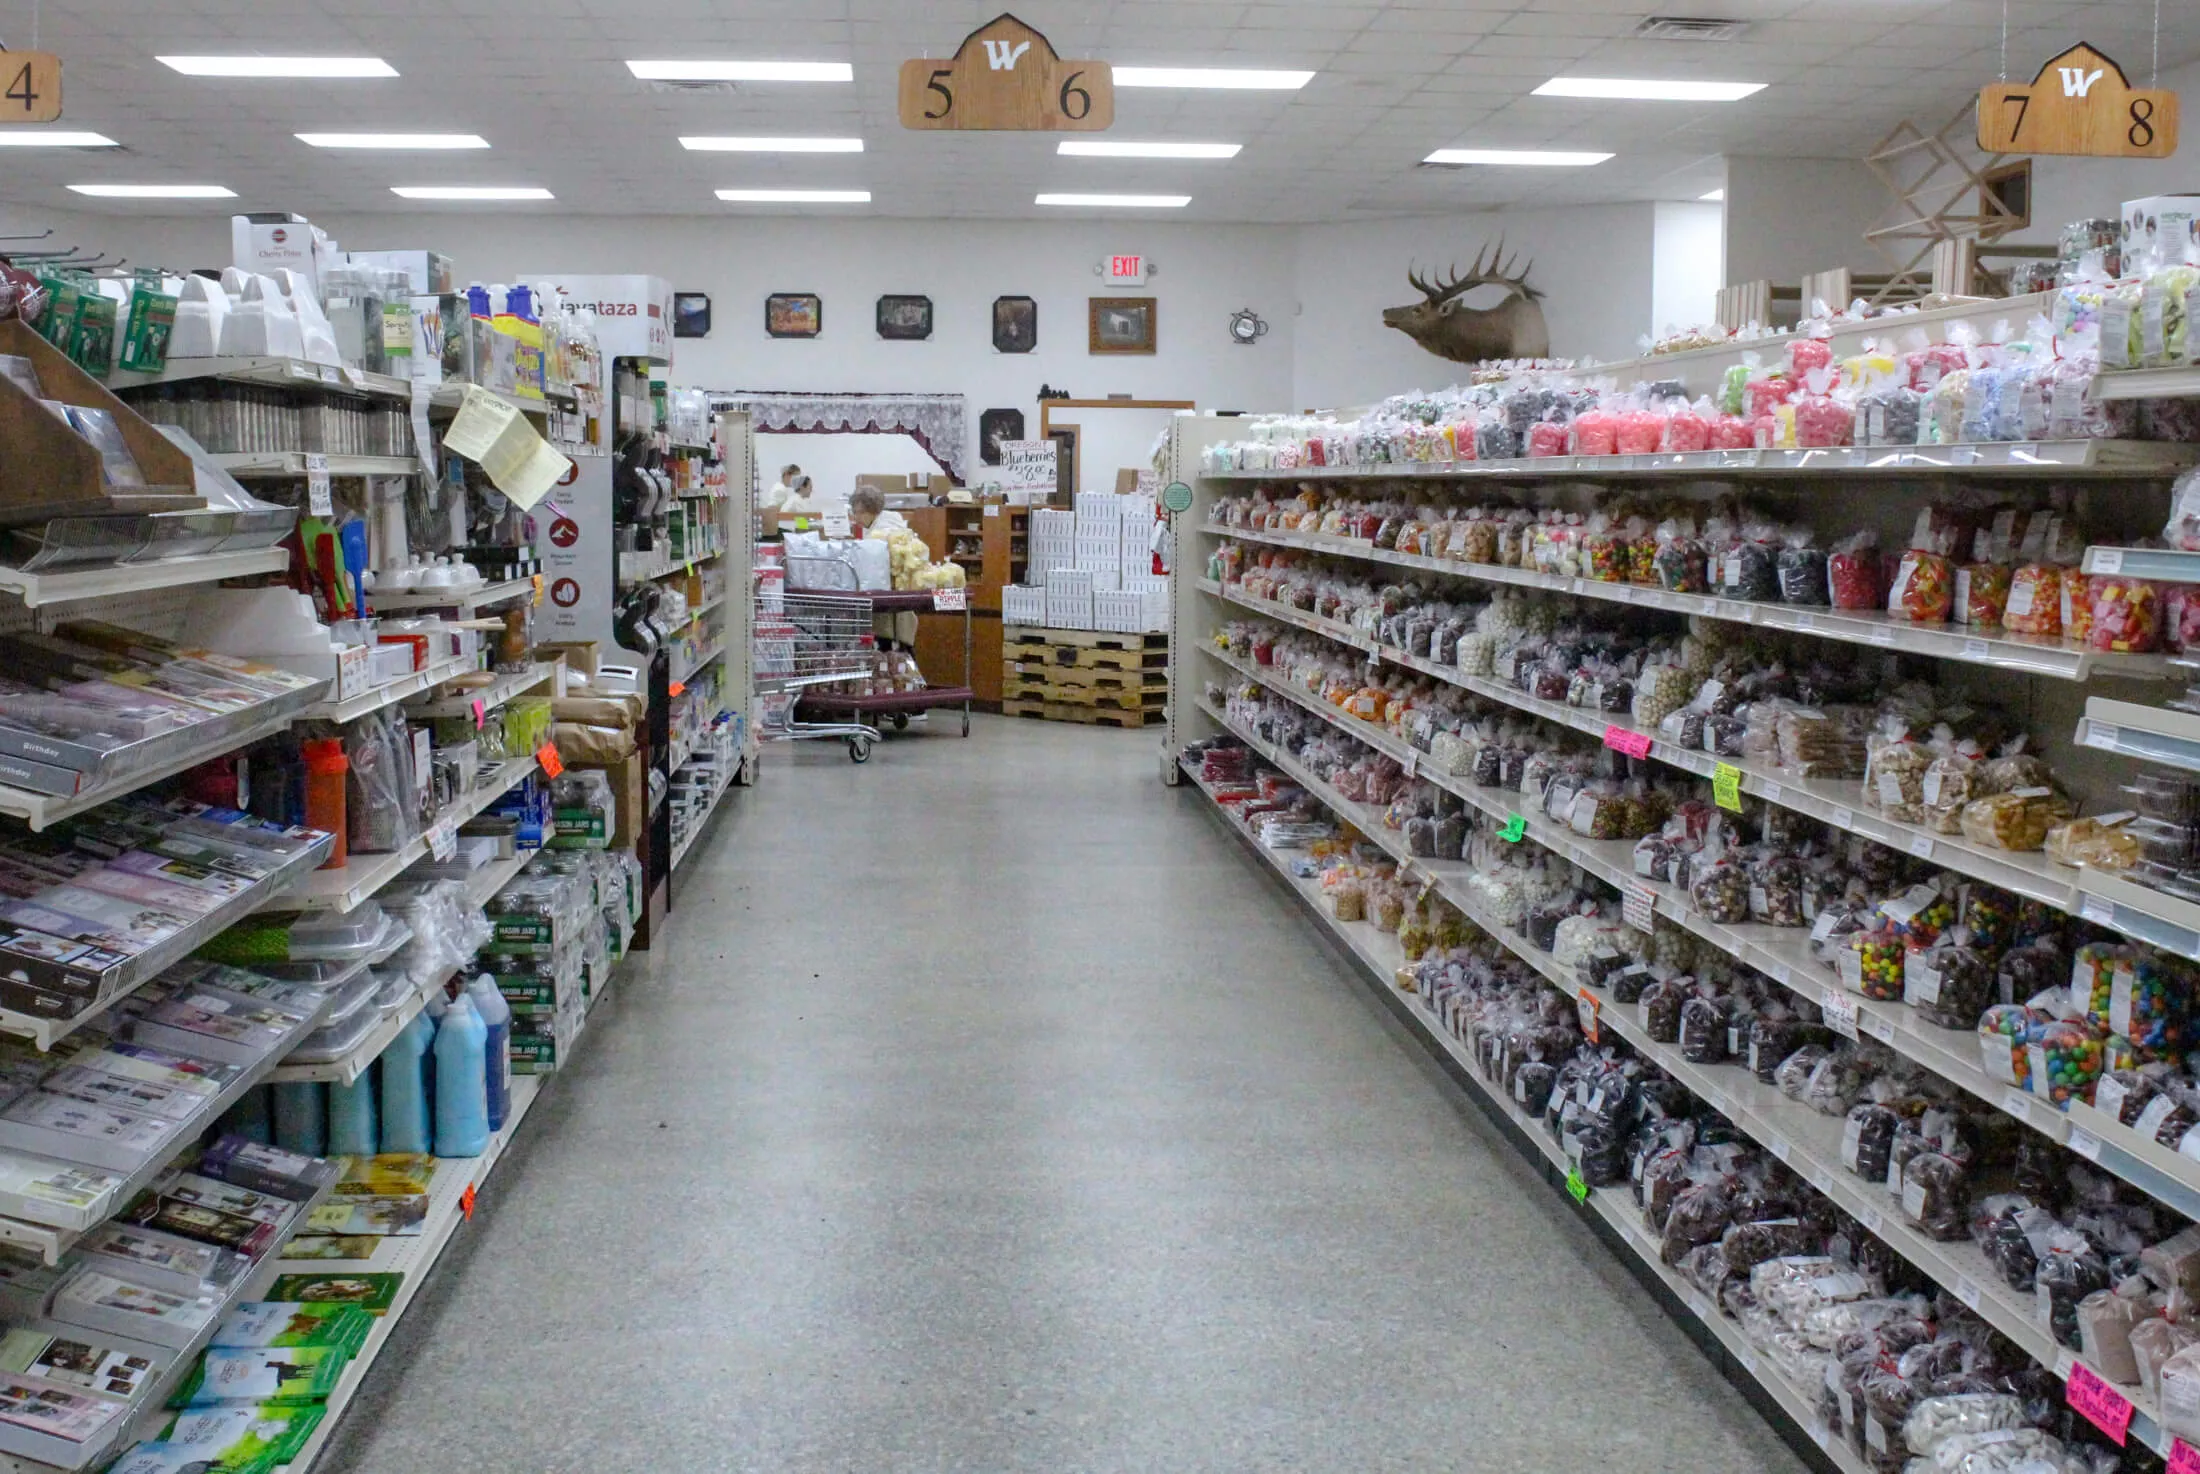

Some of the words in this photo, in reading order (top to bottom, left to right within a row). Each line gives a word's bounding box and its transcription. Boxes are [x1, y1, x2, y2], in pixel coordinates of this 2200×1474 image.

[983, 40, 1030, 70] W
[5, 61, 39, 112] 4
[2057, 67, 2104, 97] W
[924, 70, 953, 119] 5
[1060, 71, 1091, 120] 6
[2002, 95, 2030, 143] 7
[2128, 98, 2154, 147] 8
[1112, 256, 1140, 277] EXIT
[1000, 450, 1057, 466] Blueberries
[23, 742, 60, 758] Birthday
[0, 766, 31, 780] irthday
[522, 926, 537, 935] JARS
[522, 987, 538, 996] JARS
